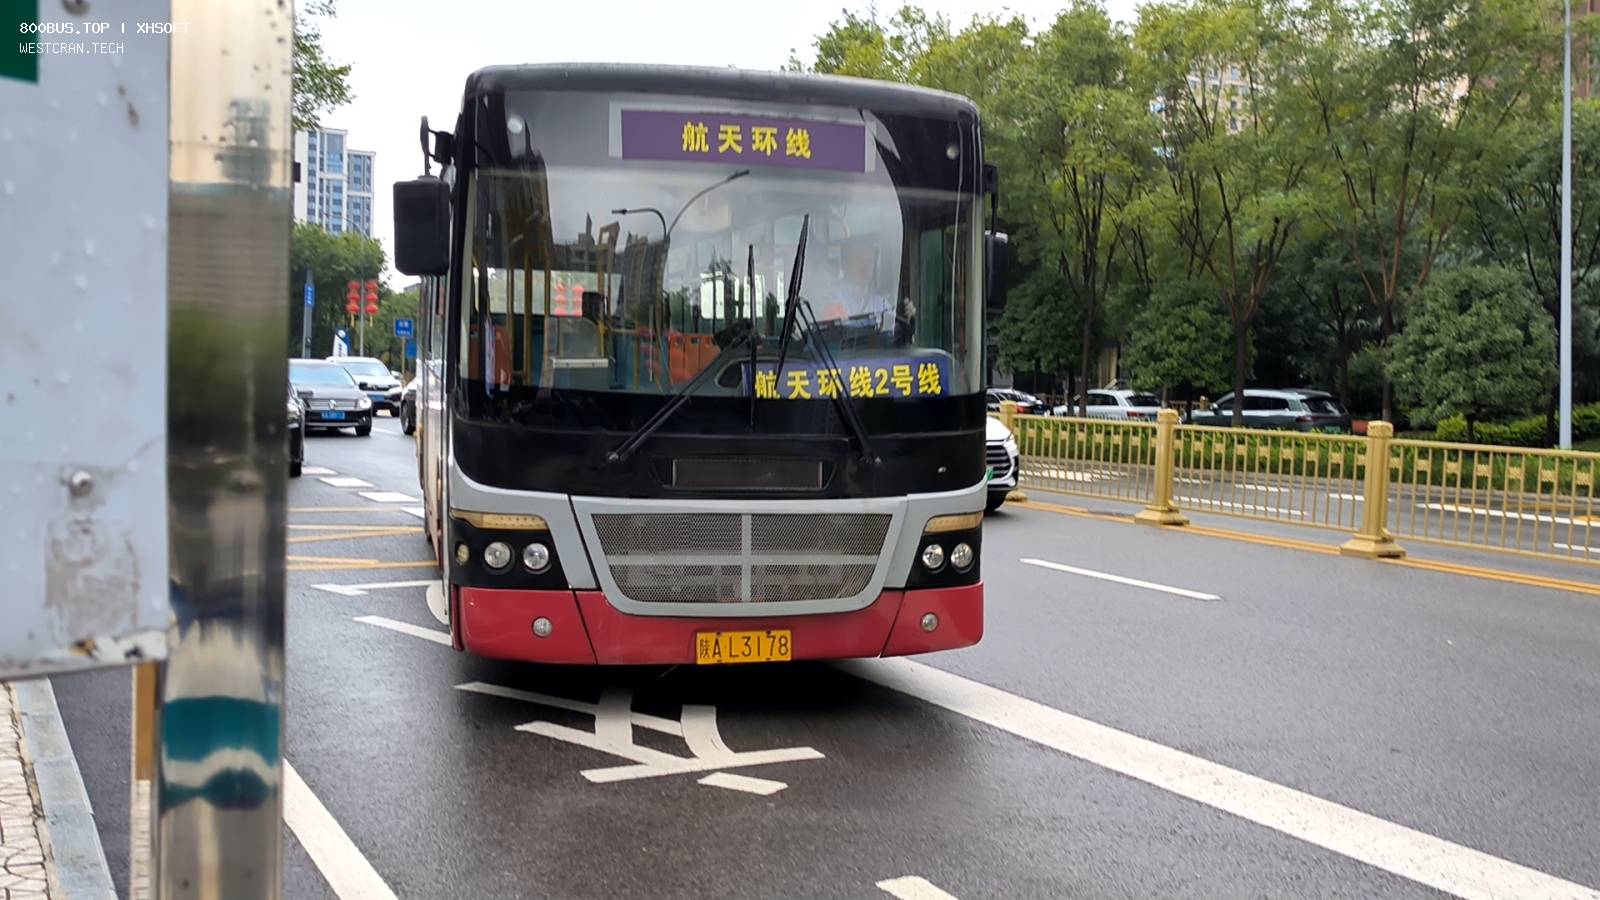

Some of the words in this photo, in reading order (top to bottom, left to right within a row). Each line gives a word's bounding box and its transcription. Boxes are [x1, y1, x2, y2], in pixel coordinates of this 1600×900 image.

[682, 121, 812, 160] 航天环线
[754, 362, 942, 400] 航天环线2号线
